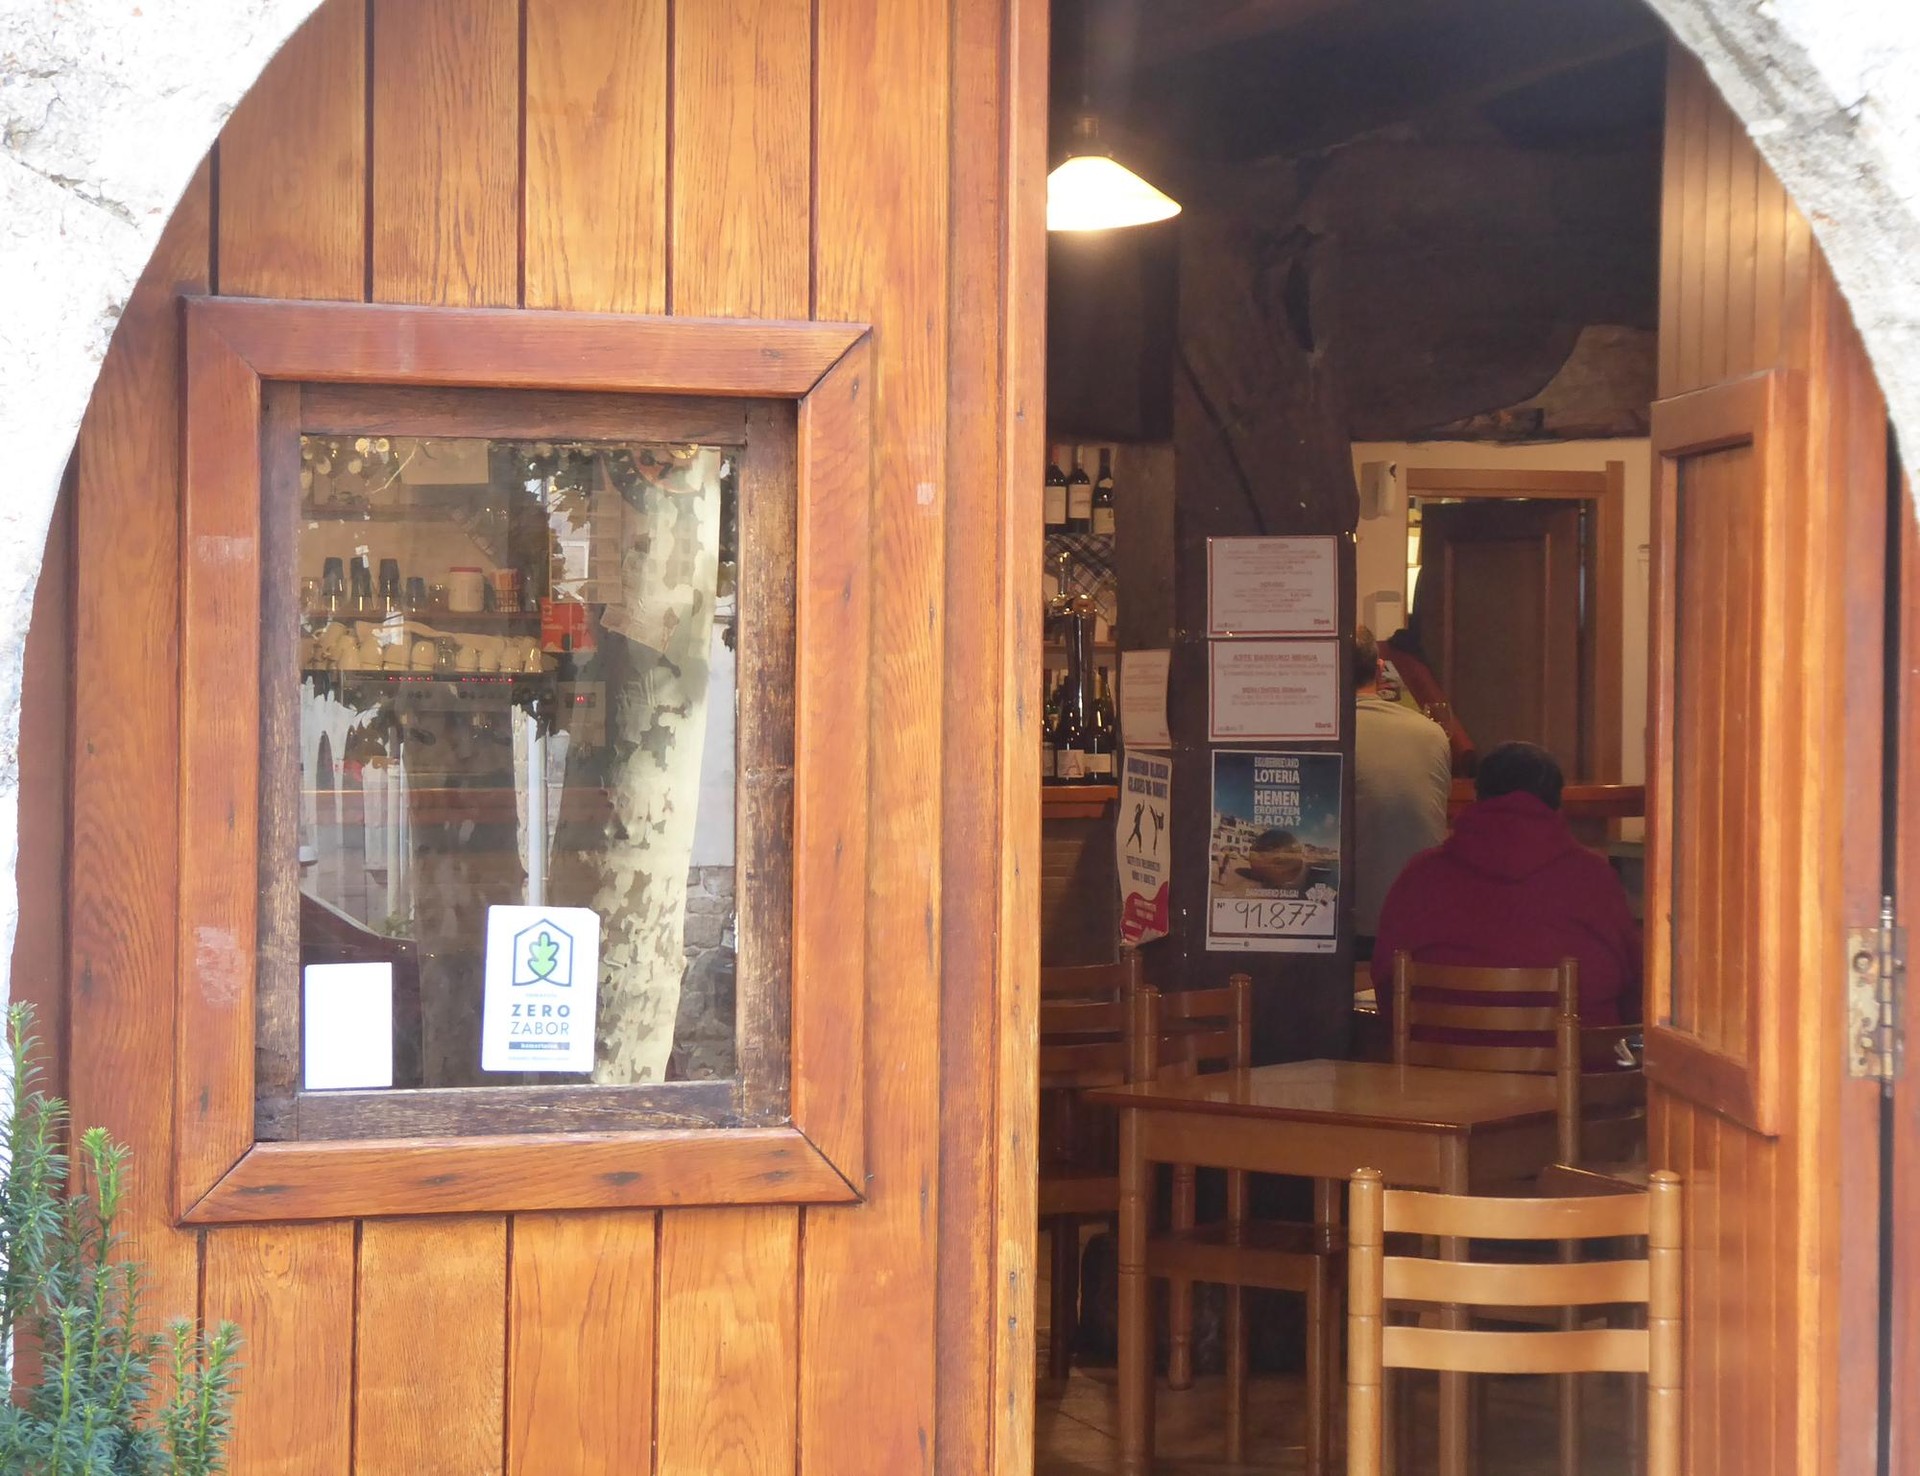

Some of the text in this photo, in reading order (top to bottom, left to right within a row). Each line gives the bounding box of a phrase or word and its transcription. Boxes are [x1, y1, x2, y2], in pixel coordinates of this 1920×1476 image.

[1254, 769, 1300, 783] LOTERIA
[1254, 790, 1300, 806] HEMEN
[1254, 815, 1302, 827] BADA?
[1234, 901, 1318, 930] 91.877
[511, 1004, 570, 1017] ZERO
[511, 1021, 569, 1036] ZABOR
